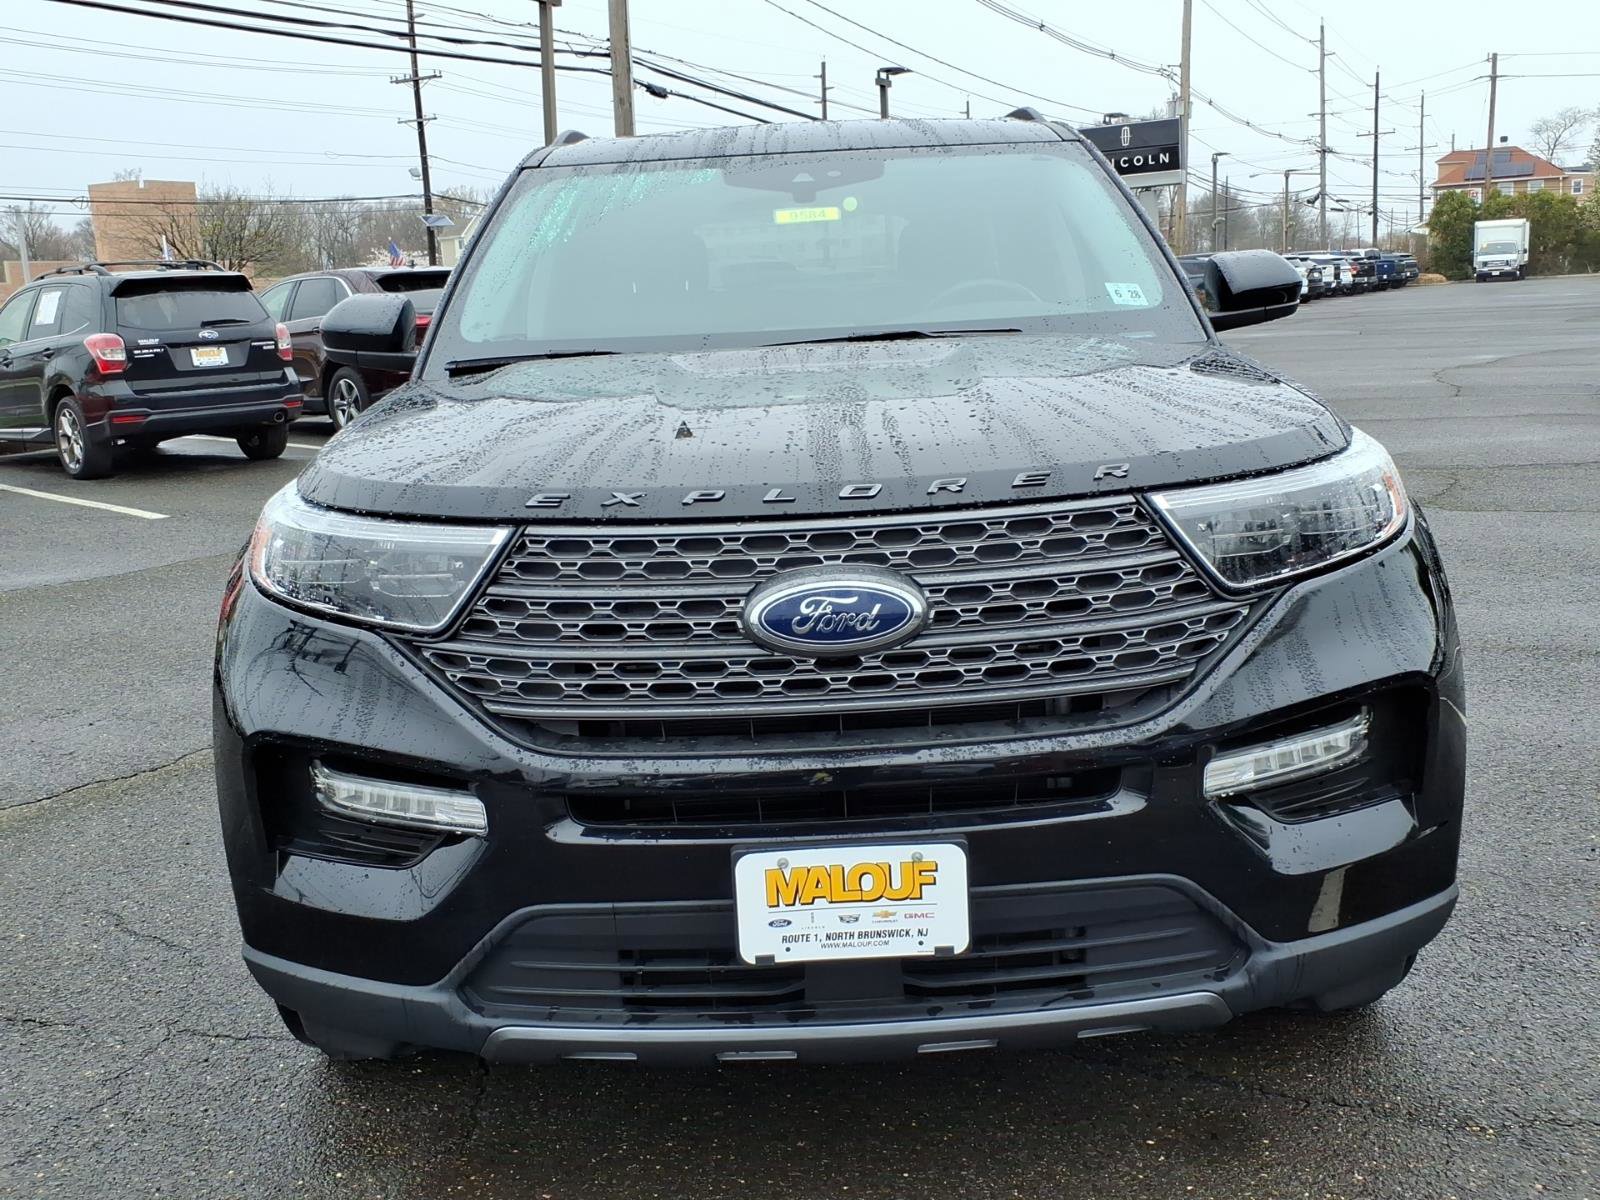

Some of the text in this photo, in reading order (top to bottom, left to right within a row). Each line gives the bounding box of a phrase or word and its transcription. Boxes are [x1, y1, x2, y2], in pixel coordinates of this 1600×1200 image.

[525, 463, 1130, 508] EXPLORER
[791, 596, 882, 634] Ford
[765, 861, 938, 908] MALOUF
[781, 928, 929, 944] ROUTE 1, NORTH BRUNSWICK, NJ
[820, 940, 890, 949] WWW.MALOUF.COM
